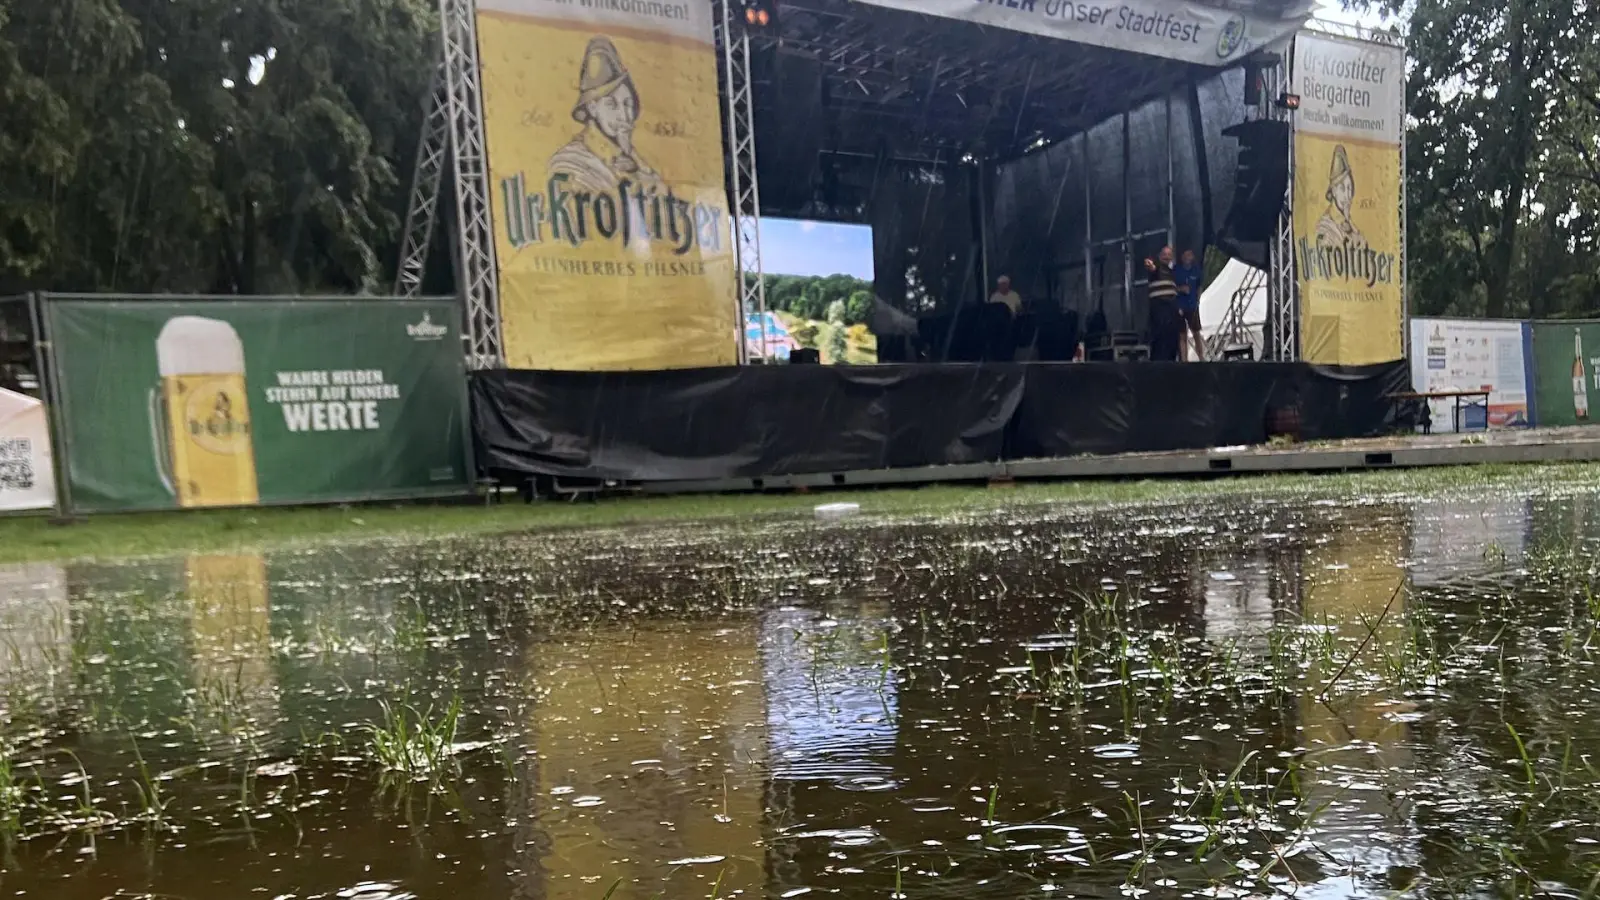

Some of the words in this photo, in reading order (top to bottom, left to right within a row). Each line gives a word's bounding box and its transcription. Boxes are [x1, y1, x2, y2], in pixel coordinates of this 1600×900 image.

[1045, 0, 1110, 25] Unser
[1116, 6, 1201, 44] Stadtfest
[1303, 47, 1386, 84] Ur-Krostitzer
[1303, 76, 1370, 108] Biergarten
[1303, 108, 1330, 124] Herzlich
[1332, 112, 1384, 131] willkommen!
[534, 256, 636, 277] FEINHERBES
[644, 261, 707, 277] PILSNER
[276, 370, 328, 386] WAHRE
[331, 369, 384, 385] HELDEN
[265, 386, 318, 403] STEHEN
[320, 386, 347, 401] AUF
[350, 384, 401, 400] INNERE
[282, 400, 380, 432] WERTE
